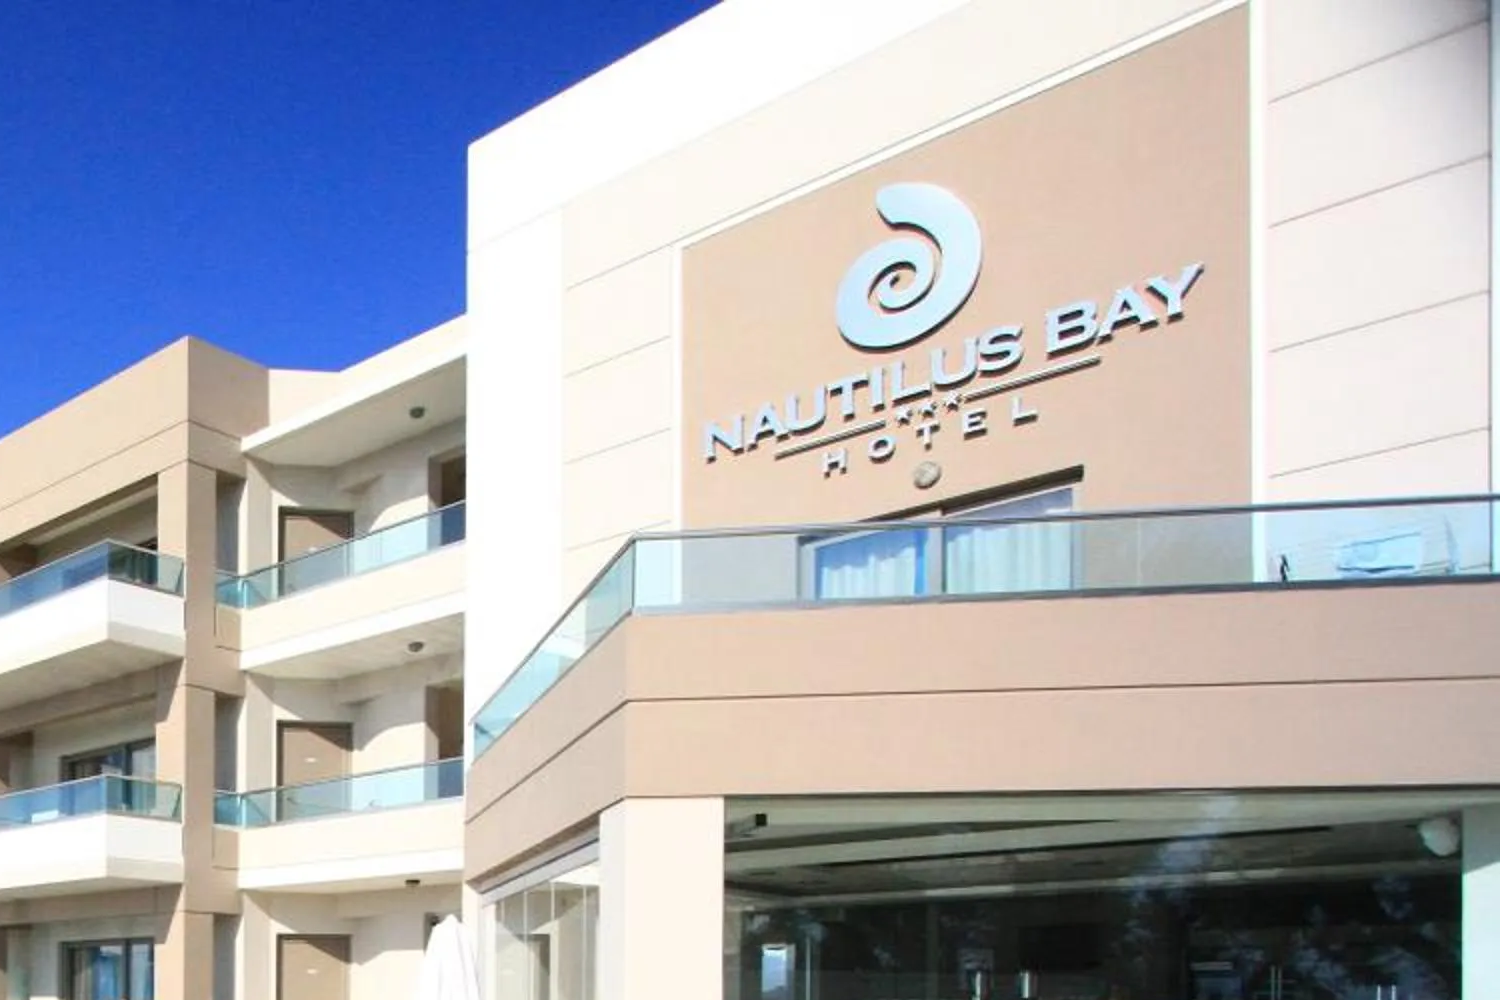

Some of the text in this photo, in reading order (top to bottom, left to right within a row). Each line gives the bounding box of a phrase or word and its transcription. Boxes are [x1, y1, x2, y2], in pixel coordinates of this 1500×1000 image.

[703, 263, 1205, 463] NAUTILUS BAY
[823, 397, 1038, 476] HOTEL
